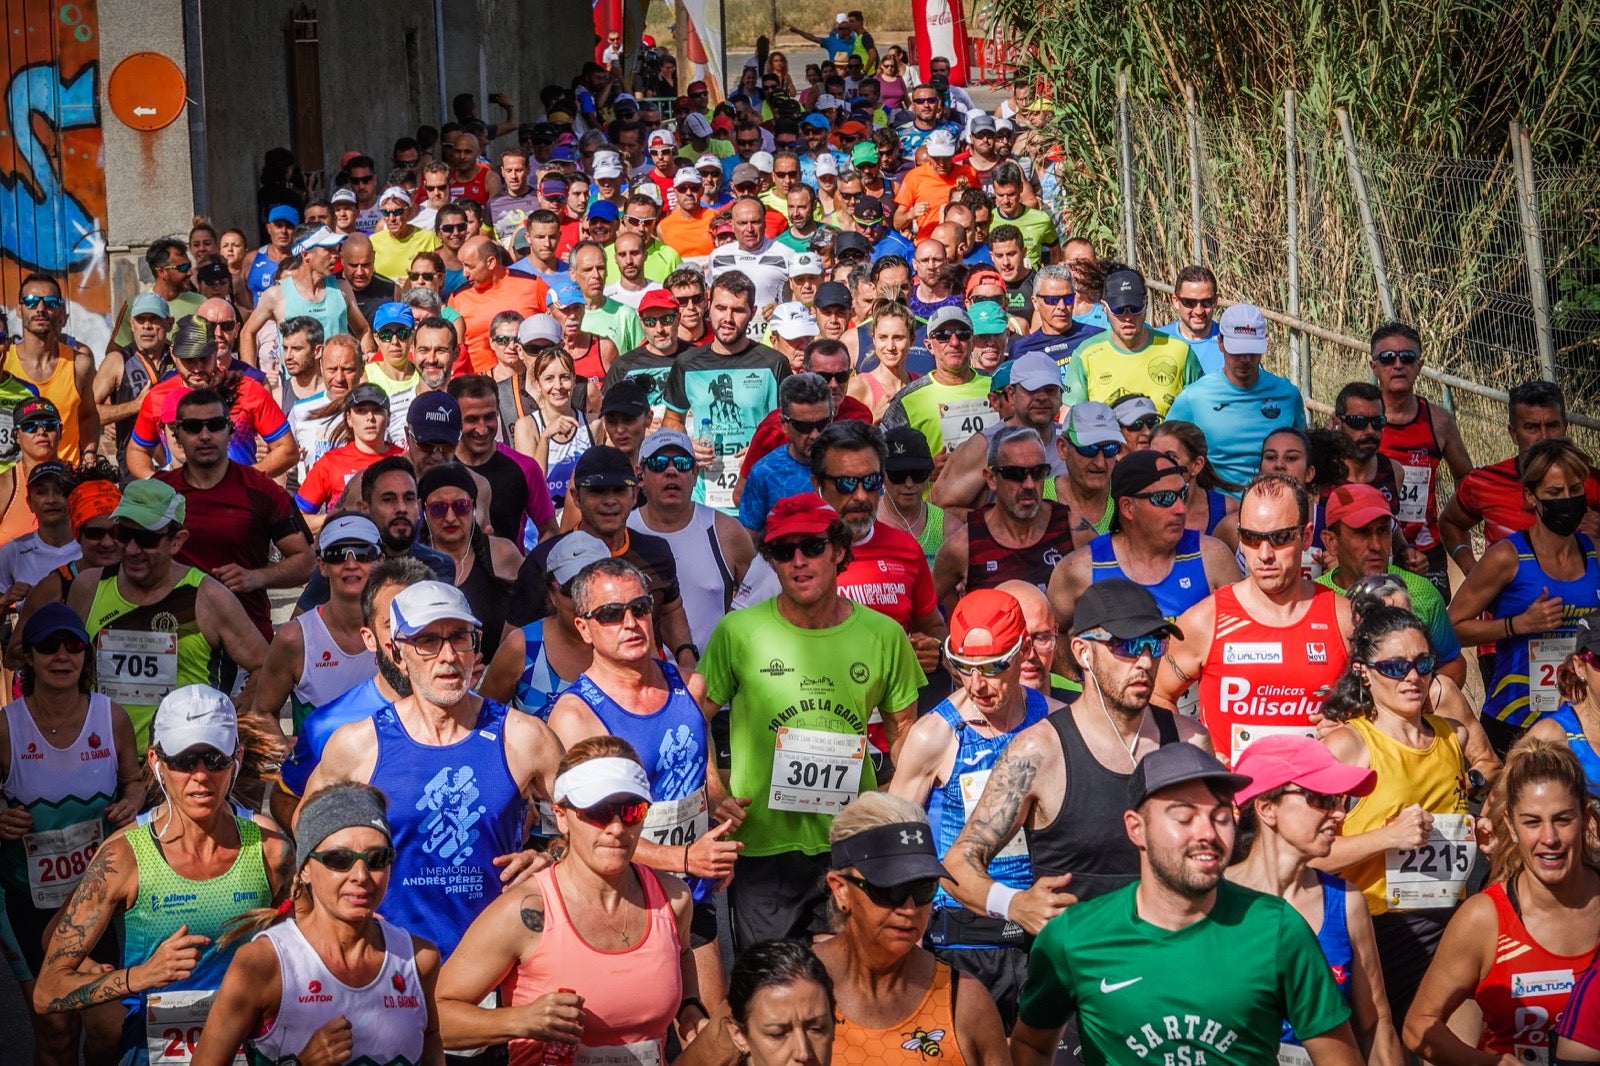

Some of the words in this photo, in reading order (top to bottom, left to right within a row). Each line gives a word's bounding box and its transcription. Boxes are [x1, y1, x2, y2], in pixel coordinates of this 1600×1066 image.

[426, 411, 446, 422] PUMA
[961, 416, 984, 433] 40
[866, 594, 876, 605] DE
[876, 593, 898, 605] FONDO
[111, 654, 159, 678] 705
[1219, 676, 1323, 716] Polisalu
[1256, 685, 1305, 696] Clínicas
[800, 698, 816, 712] DE
[818, 698, 832, 712] LA
[787, 760, 849, 790] 3017
[653, 819, 697, 847] 704
[1398, 844, 1469, 873] 2215
[426, 865, 485, 876] MEMORIAL
[402, 873, 447, 887] ANDRÉS
[448, 872, 484, 884] PÉREZ
[444, 884, 484, 895] PRIETO
[468, 891, 484, 900] 2019
[298, 994, 333, 1004] VIATOR
[1125, 1014, 1239, 1058] SARTHE
